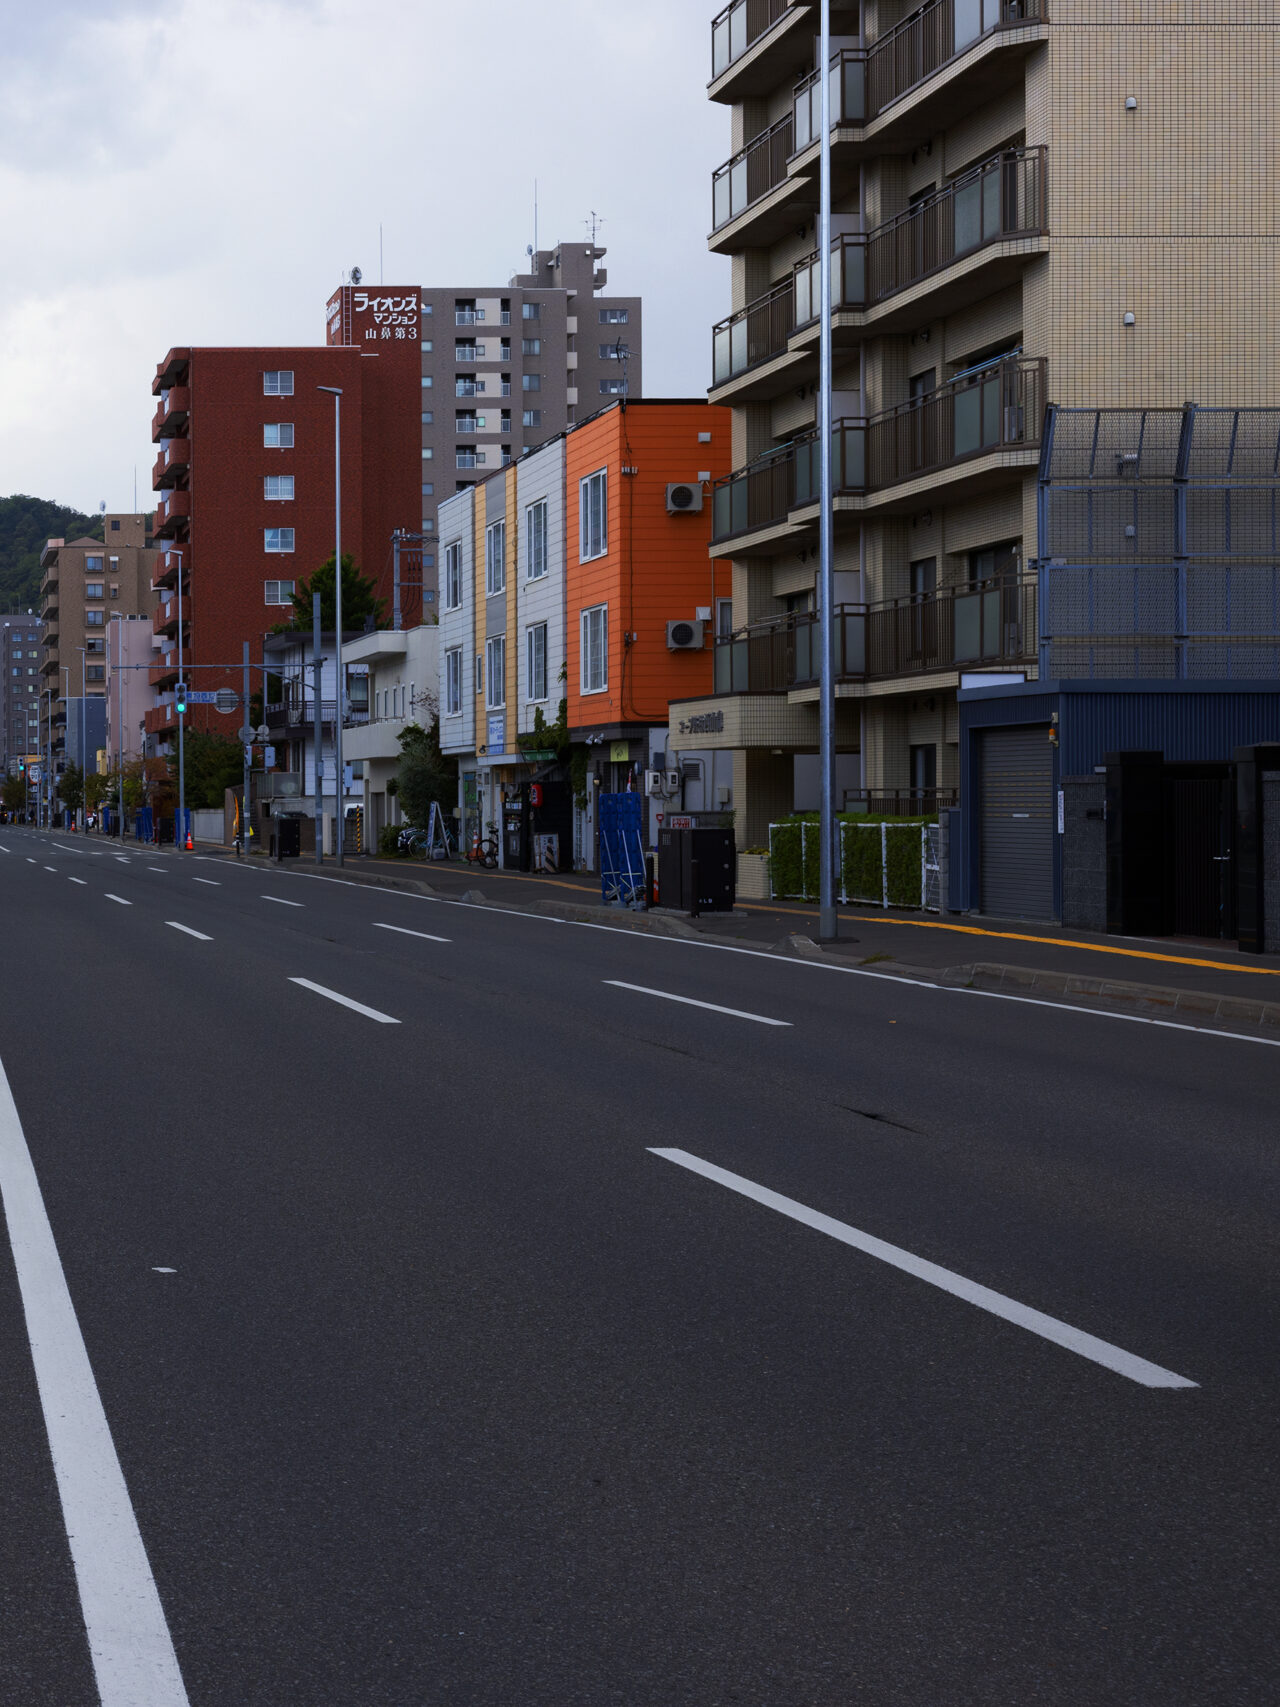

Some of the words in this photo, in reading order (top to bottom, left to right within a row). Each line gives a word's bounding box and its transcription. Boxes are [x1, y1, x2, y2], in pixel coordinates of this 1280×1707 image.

[353, 293, 417, 311] ライオンズ
[373, 313, 417, 325] マンション
[365, 327, 417, 340] 山鼻第3
